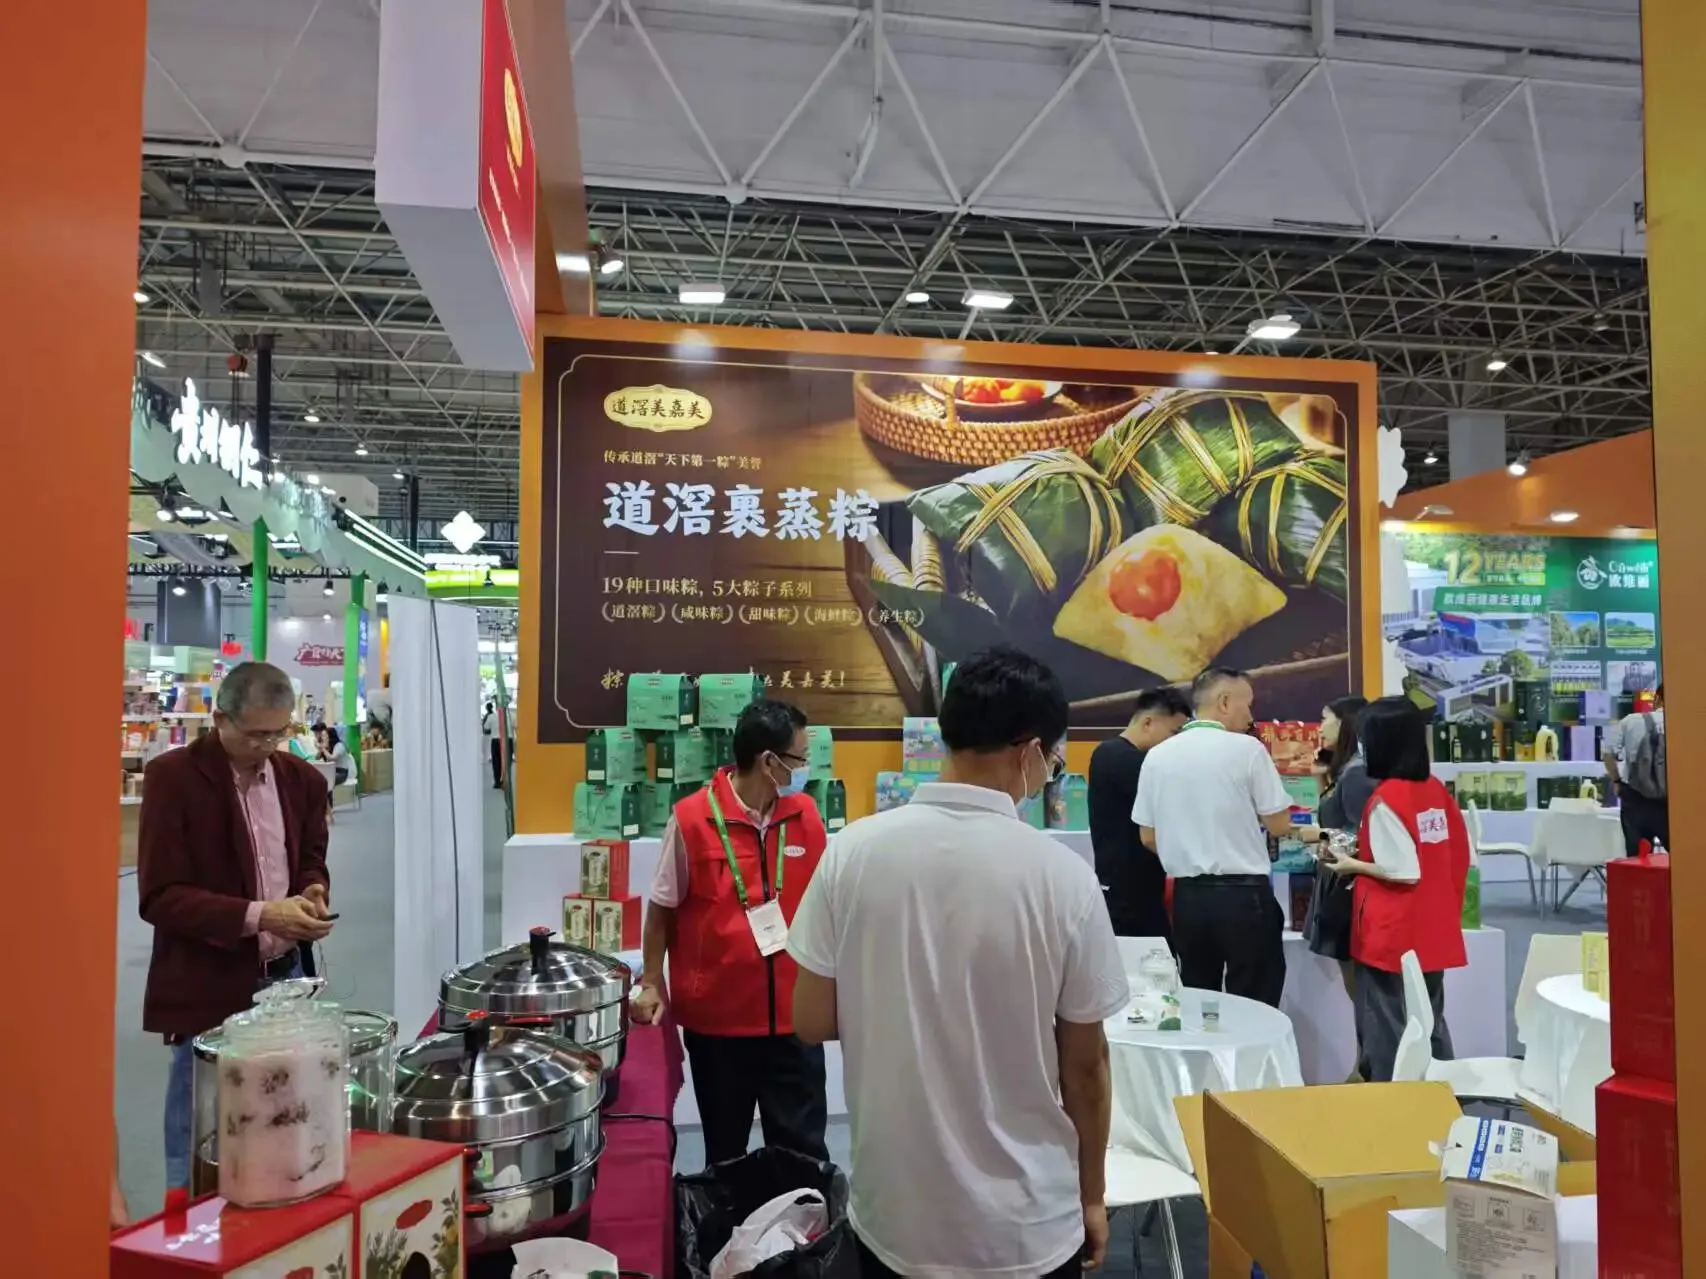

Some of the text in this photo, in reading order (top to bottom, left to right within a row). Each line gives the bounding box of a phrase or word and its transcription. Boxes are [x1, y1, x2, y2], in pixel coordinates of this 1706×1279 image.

[602, 479, 880, 542] 道滘裹蒸粽
[1443, 549, 1481, 584] 12
